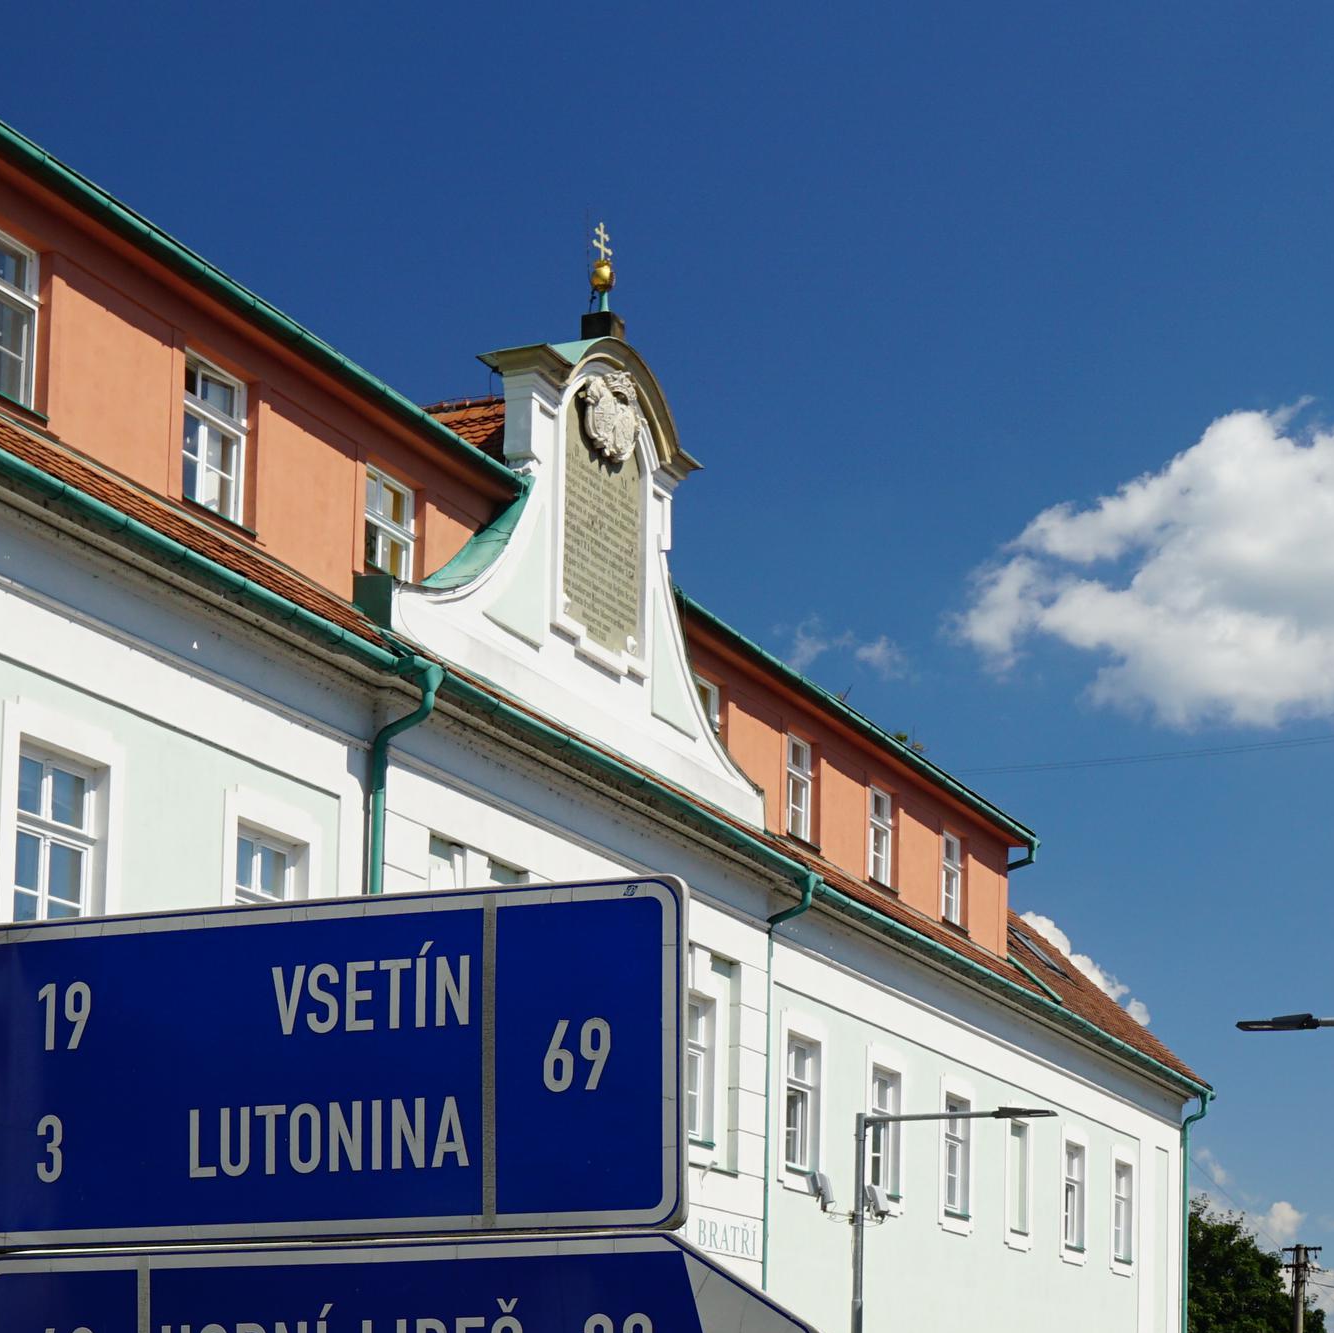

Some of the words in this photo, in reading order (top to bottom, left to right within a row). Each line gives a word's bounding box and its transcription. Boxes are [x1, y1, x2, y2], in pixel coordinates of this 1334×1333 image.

[37, 980, 92, 1052] 19
[270, 939, 471, 1036] VSETÍN
[542, 1016, 612, 1094] 69
[36, 1113, 64, 1184] 3
[188, 1095, 471, 1179] LUTONINA
[697, 1218, 758, 1257] BRATŘÍ
